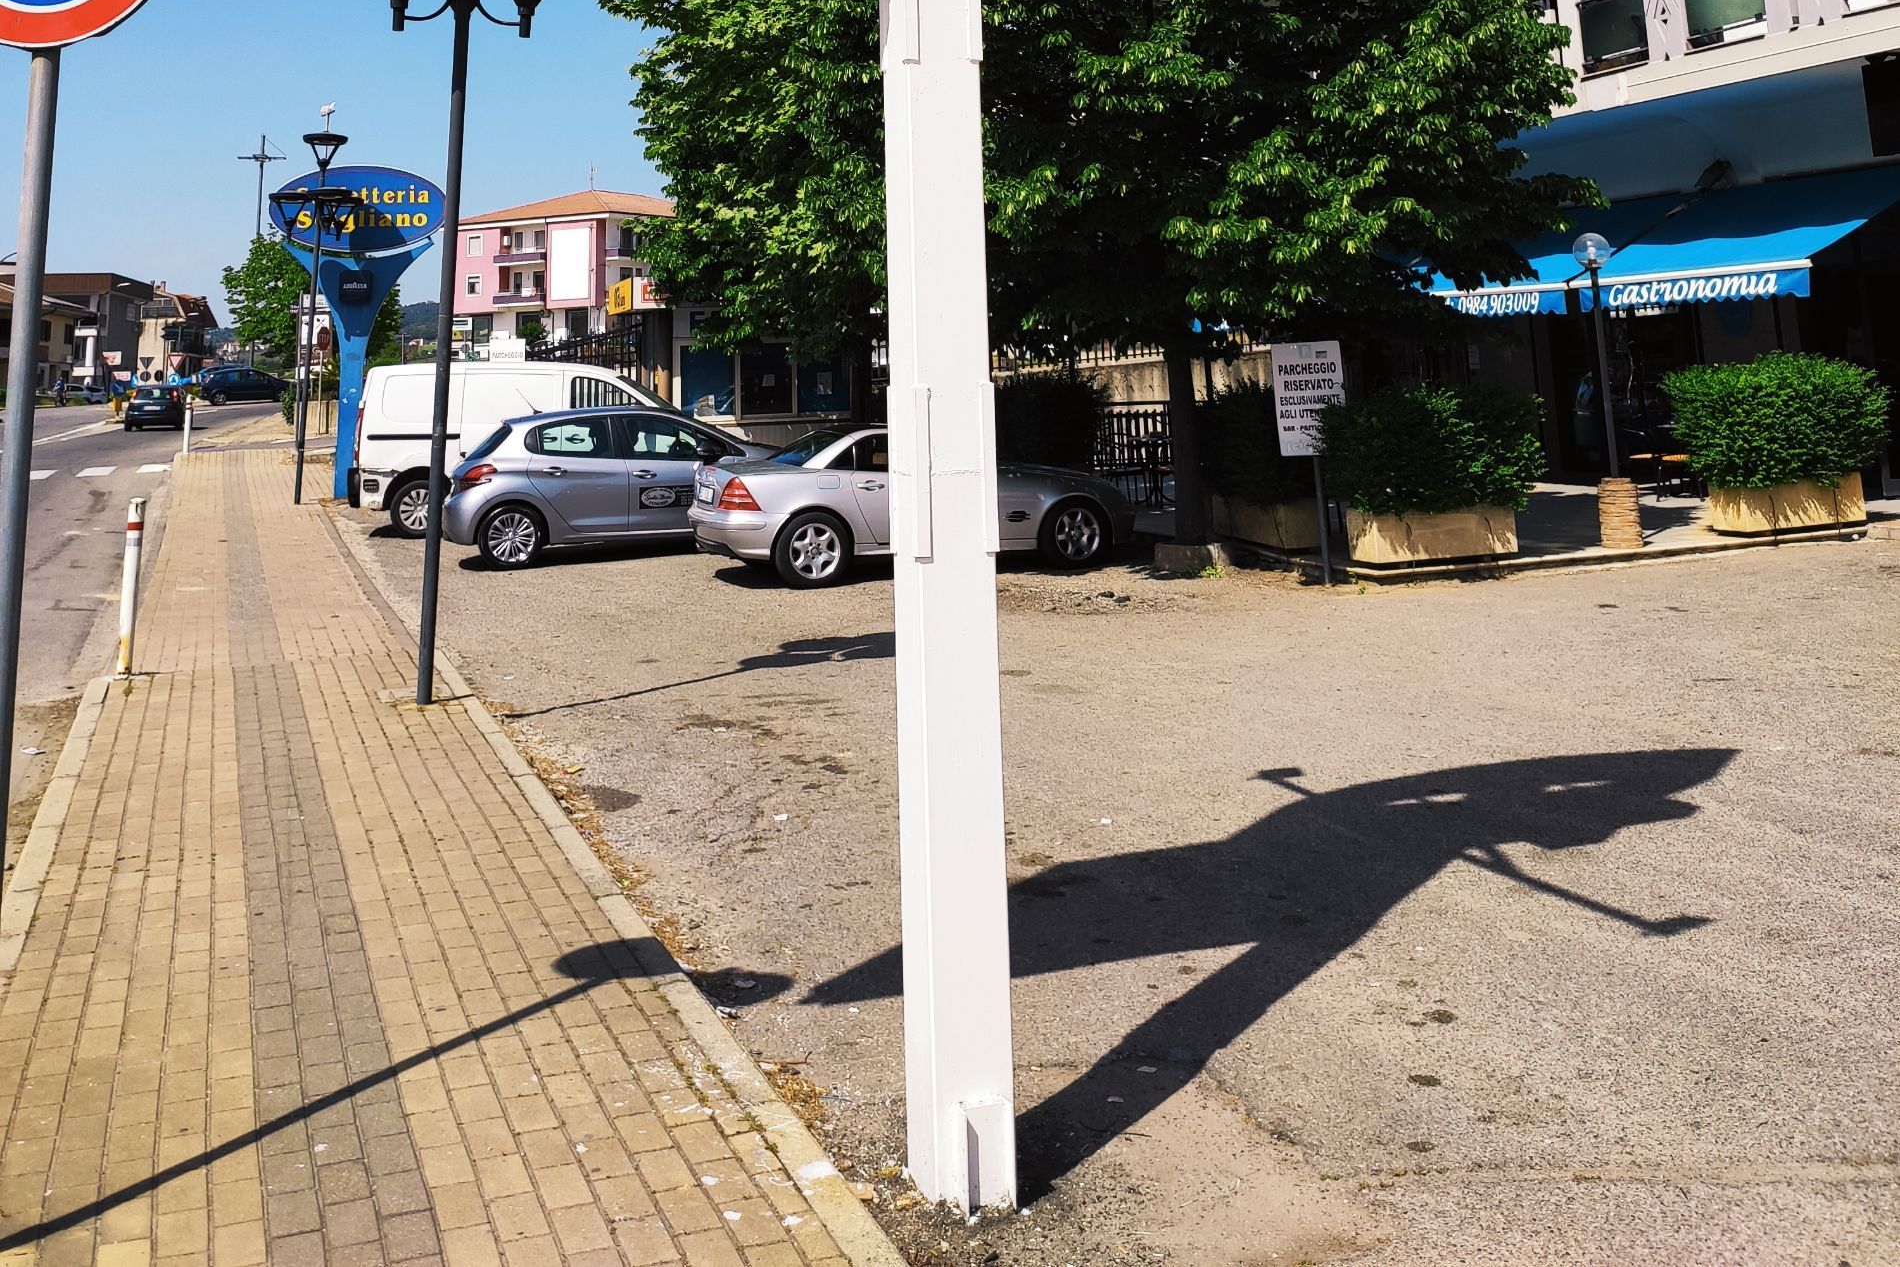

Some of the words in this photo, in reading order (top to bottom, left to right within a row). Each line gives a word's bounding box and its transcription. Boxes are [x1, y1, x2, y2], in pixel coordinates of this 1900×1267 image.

[296, 208, 428, 233] Sgliano
[1608, 272, 1778, 306] Gastronomia
[1458, 295, 1488, 315] 0984
[1489, 292, 1540, 316] 903009
[1278, 361, 1337, 376] PARCHEGGIO
[1284, 378, 1334, 392] RISERVATO
[1279, 393, 1341, 407] ESCLUSIVAMENTE
[1279, 409, 1297, 420] AGLI
